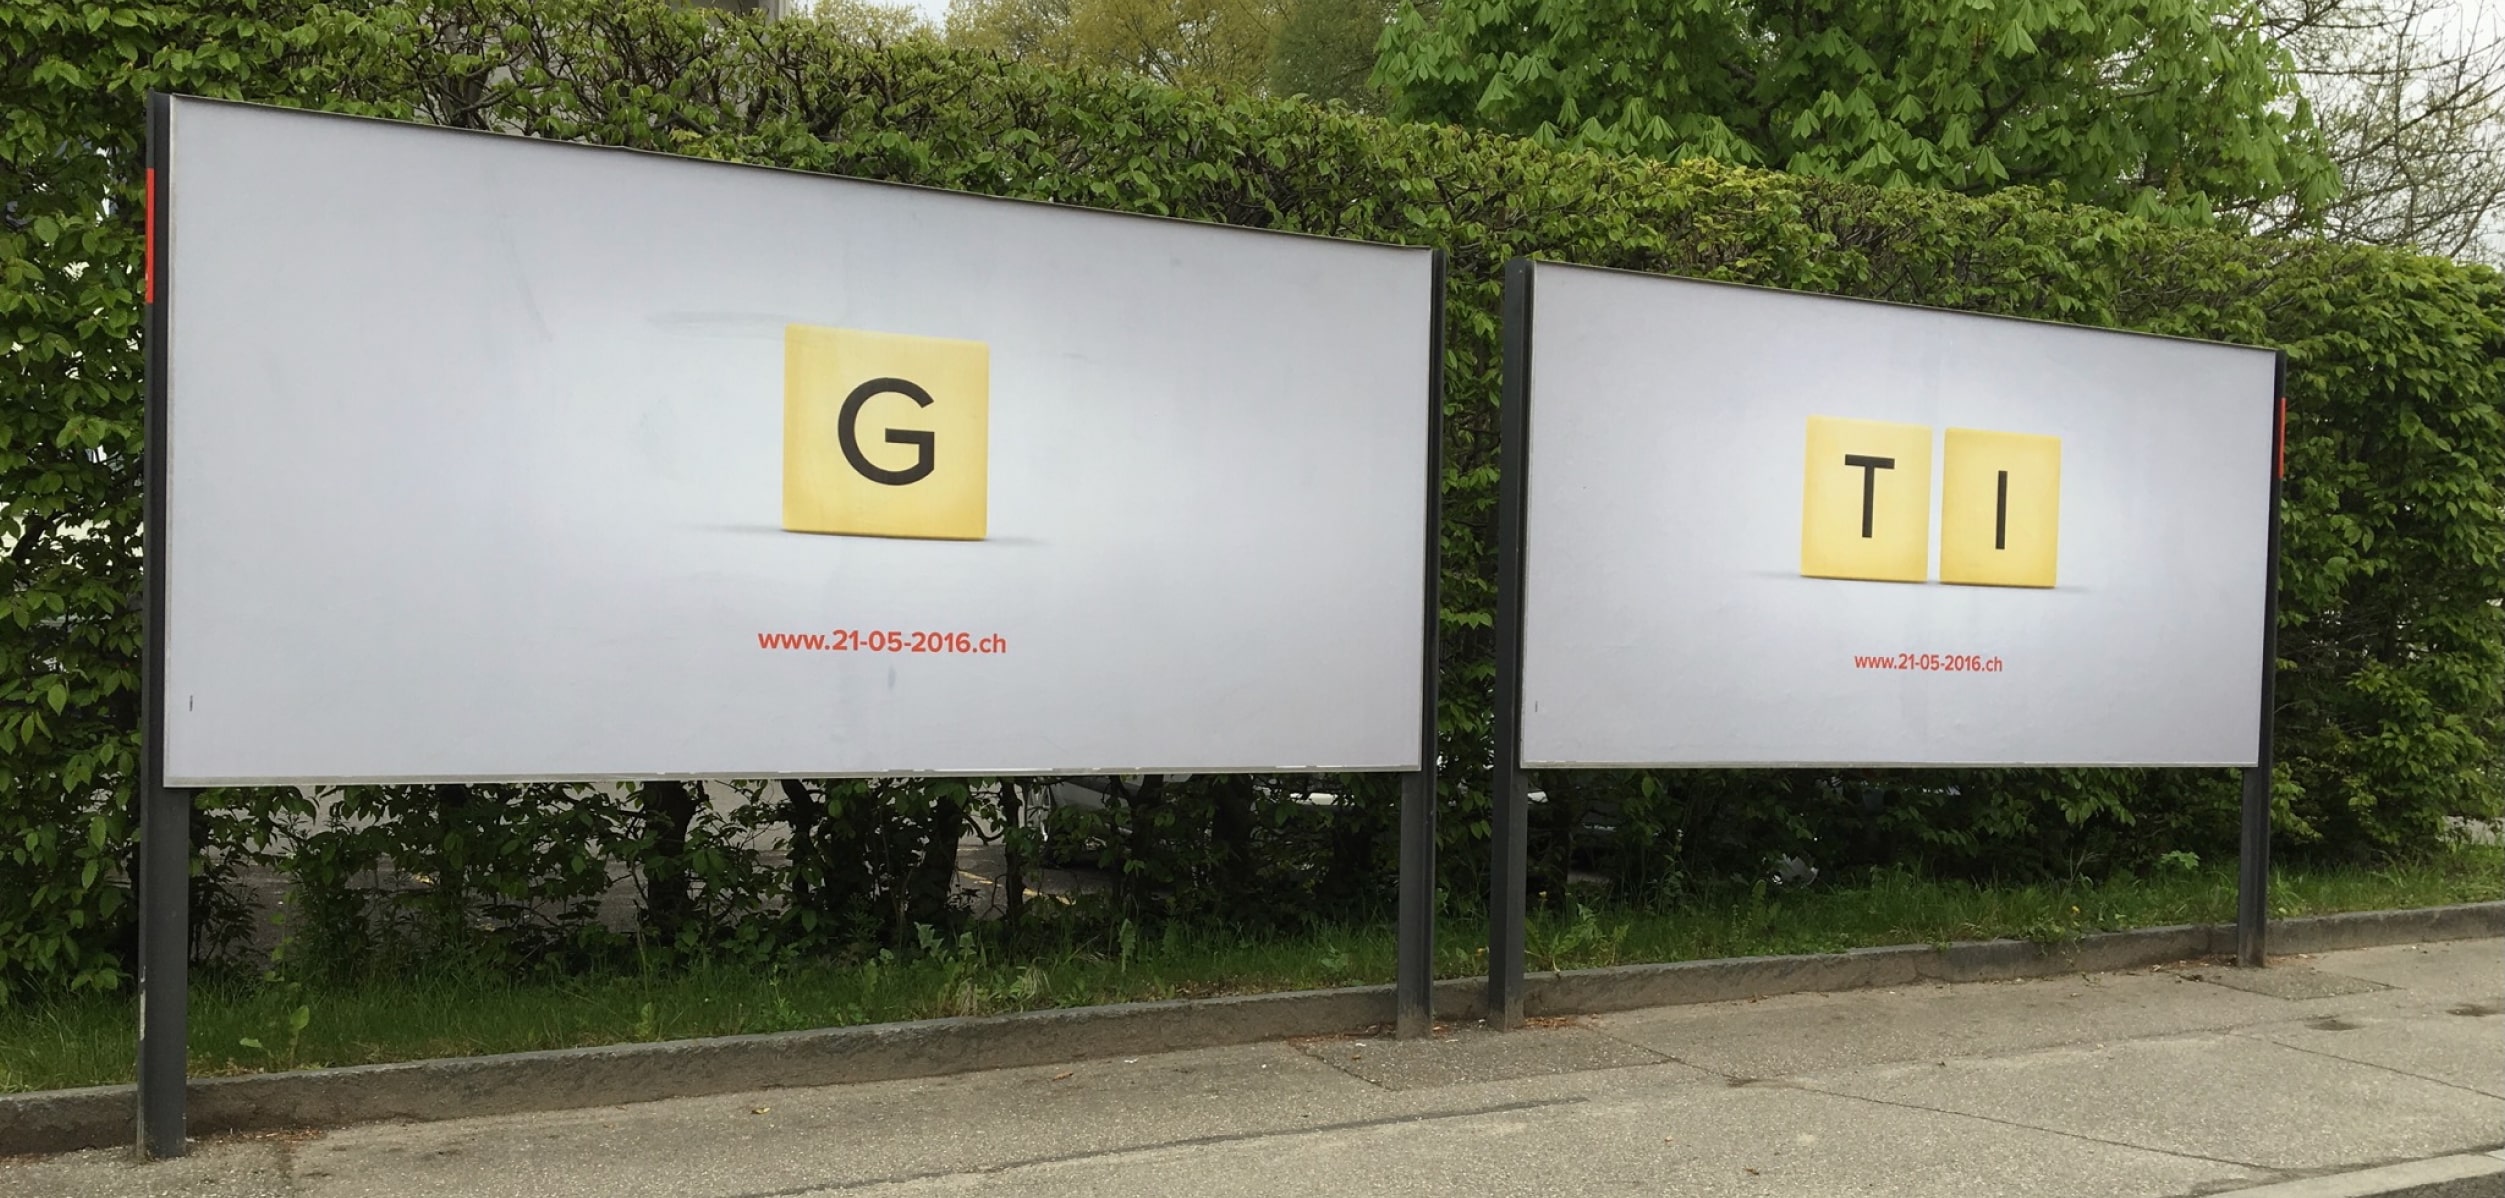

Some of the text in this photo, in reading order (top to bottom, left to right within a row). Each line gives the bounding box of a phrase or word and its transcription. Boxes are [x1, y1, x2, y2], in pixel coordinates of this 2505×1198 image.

[837, 377, 936, 486] G
[757, 628, 1008, 654] www.21-05-2016.ch
[1854, 652, 2003, 672] www.21-05-2016.ch
